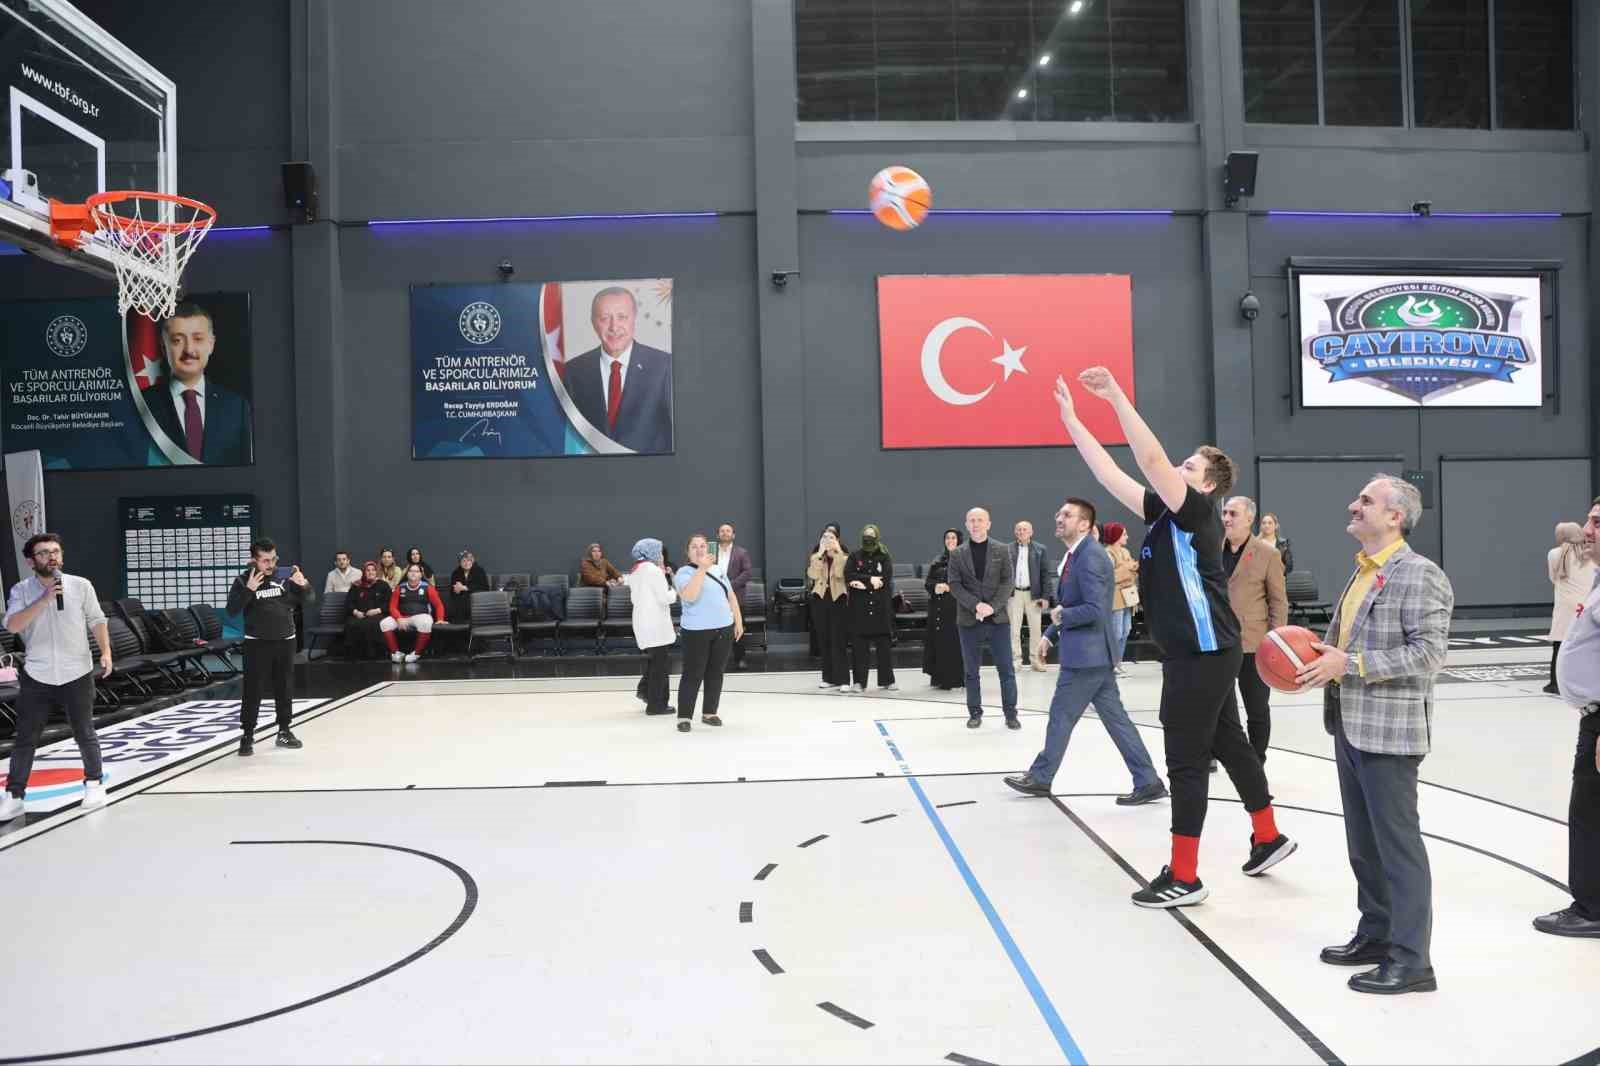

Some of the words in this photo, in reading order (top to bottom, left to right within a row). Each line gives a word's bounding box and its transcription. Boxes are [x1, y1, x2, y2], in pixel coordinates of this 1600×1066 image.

[21, 63, 99, 117] www.tbf.org.tr
[435, 355, 461, 368] TÜM
[464, 354, 526, 368] ANTRENÖR
[23, 368, 48, 380] TÜM
[51, 366, 112, 380] ANTRENÖR
[422, 369, 437, 380] VE
[439, 367, 539, 380] SPORCULARIMIZA
[9, 382, 24, 393] VE
[26, 379, 124, 392] SPORCULARIMIZA
[425, 381, 480, 392] BAŞARILAR
[482, 379, 536, 391] DİLİYORUM
[70, 391, 122, 402] DİLİYORUM
[486, 400, 519, 409] ERDOĞAN
[255, 587, 282, 600] PUMA
